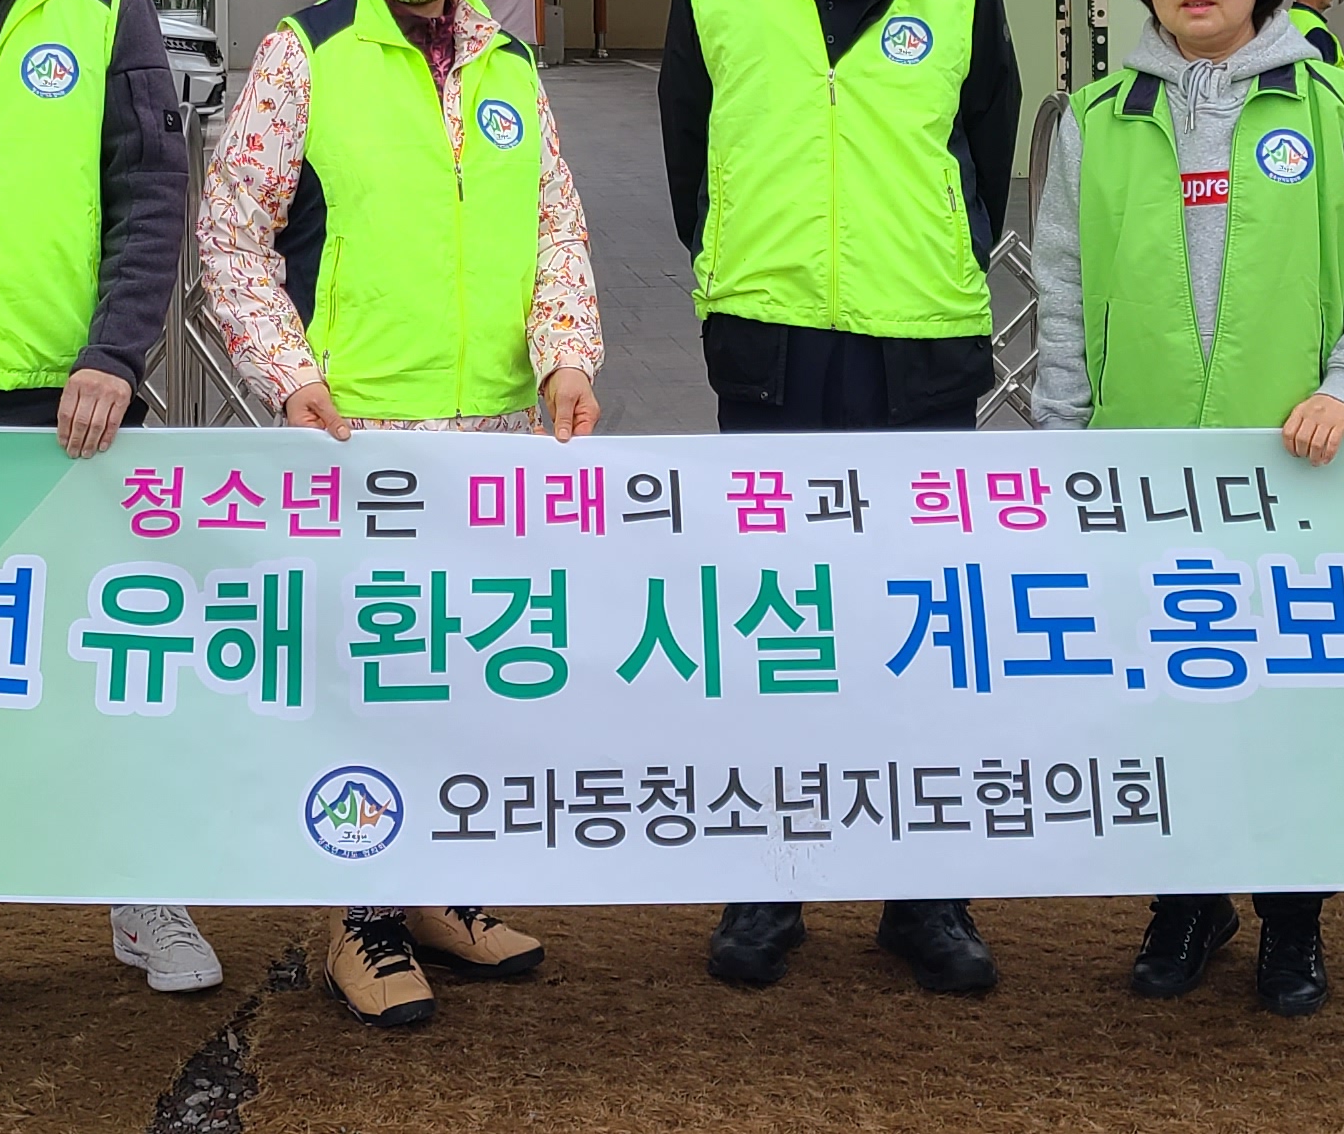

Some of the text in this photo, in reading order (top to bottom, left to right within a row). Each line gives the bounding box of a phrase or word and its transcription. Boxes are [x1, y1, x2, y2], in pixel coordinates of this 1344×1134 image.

[120, 465, 1313, 539] 청소년은 미래의 꿈과 희망입니다.
[79, 568, 306, 708] 유해
[347, 567, 570, 705] 환경
[614, 562, 843, 701] 시설
[429, 755, 1174, 850] 오라동청소년지도협의회
